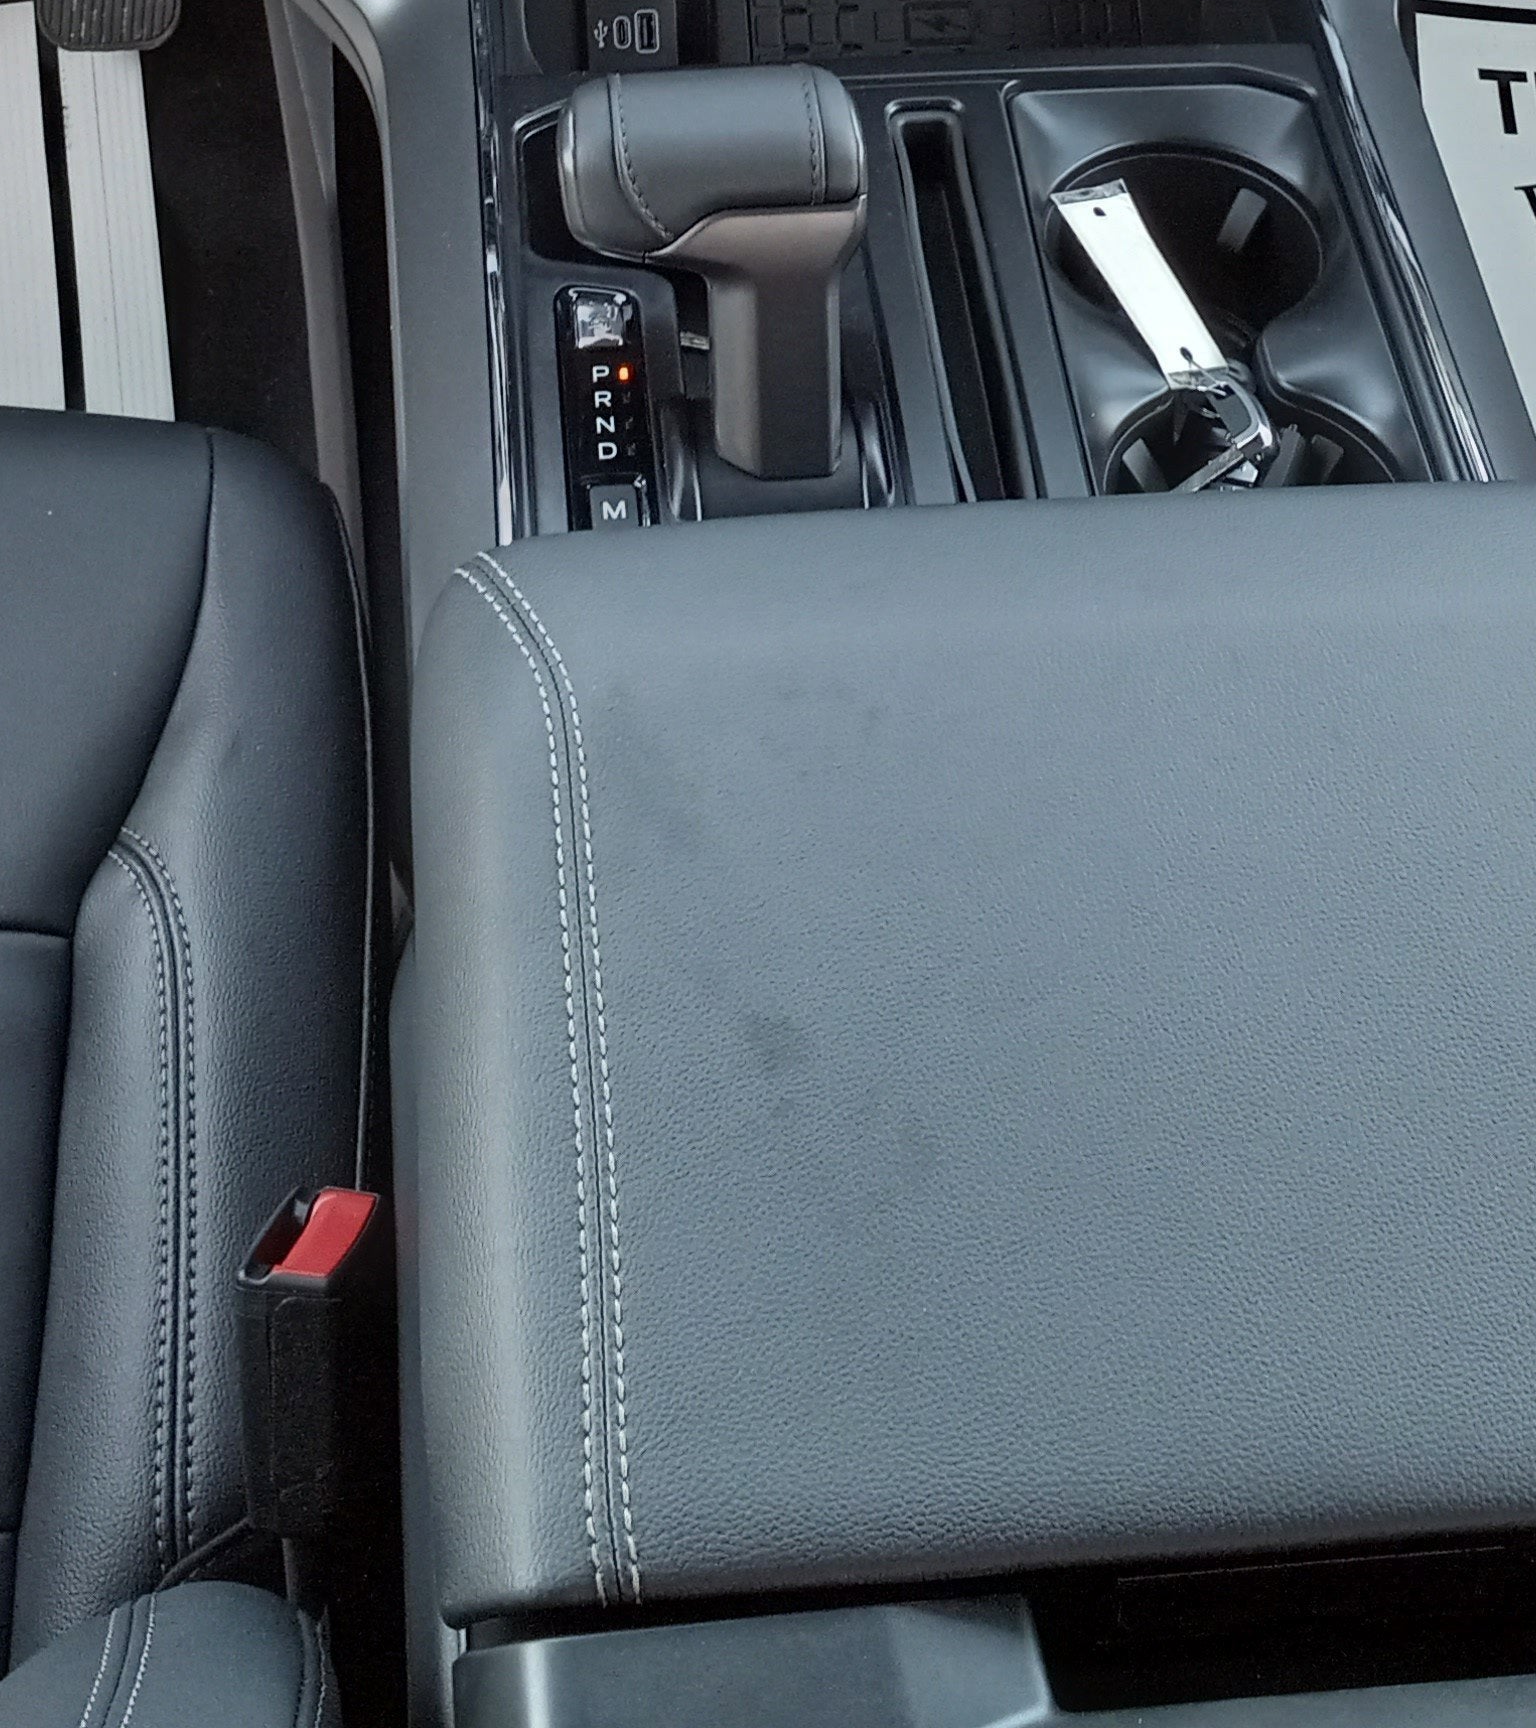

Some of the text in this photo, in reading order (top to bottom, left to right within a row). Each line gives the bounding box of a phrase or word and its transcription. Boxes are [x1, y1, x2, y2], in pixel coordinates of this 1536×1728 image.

[592, 365, 610, 384] P
[594, 390, 612, 409] R
[596, 415, 616, 435] N
[598, 441, 618, 461] D
[602, 500, 627, 521] M
